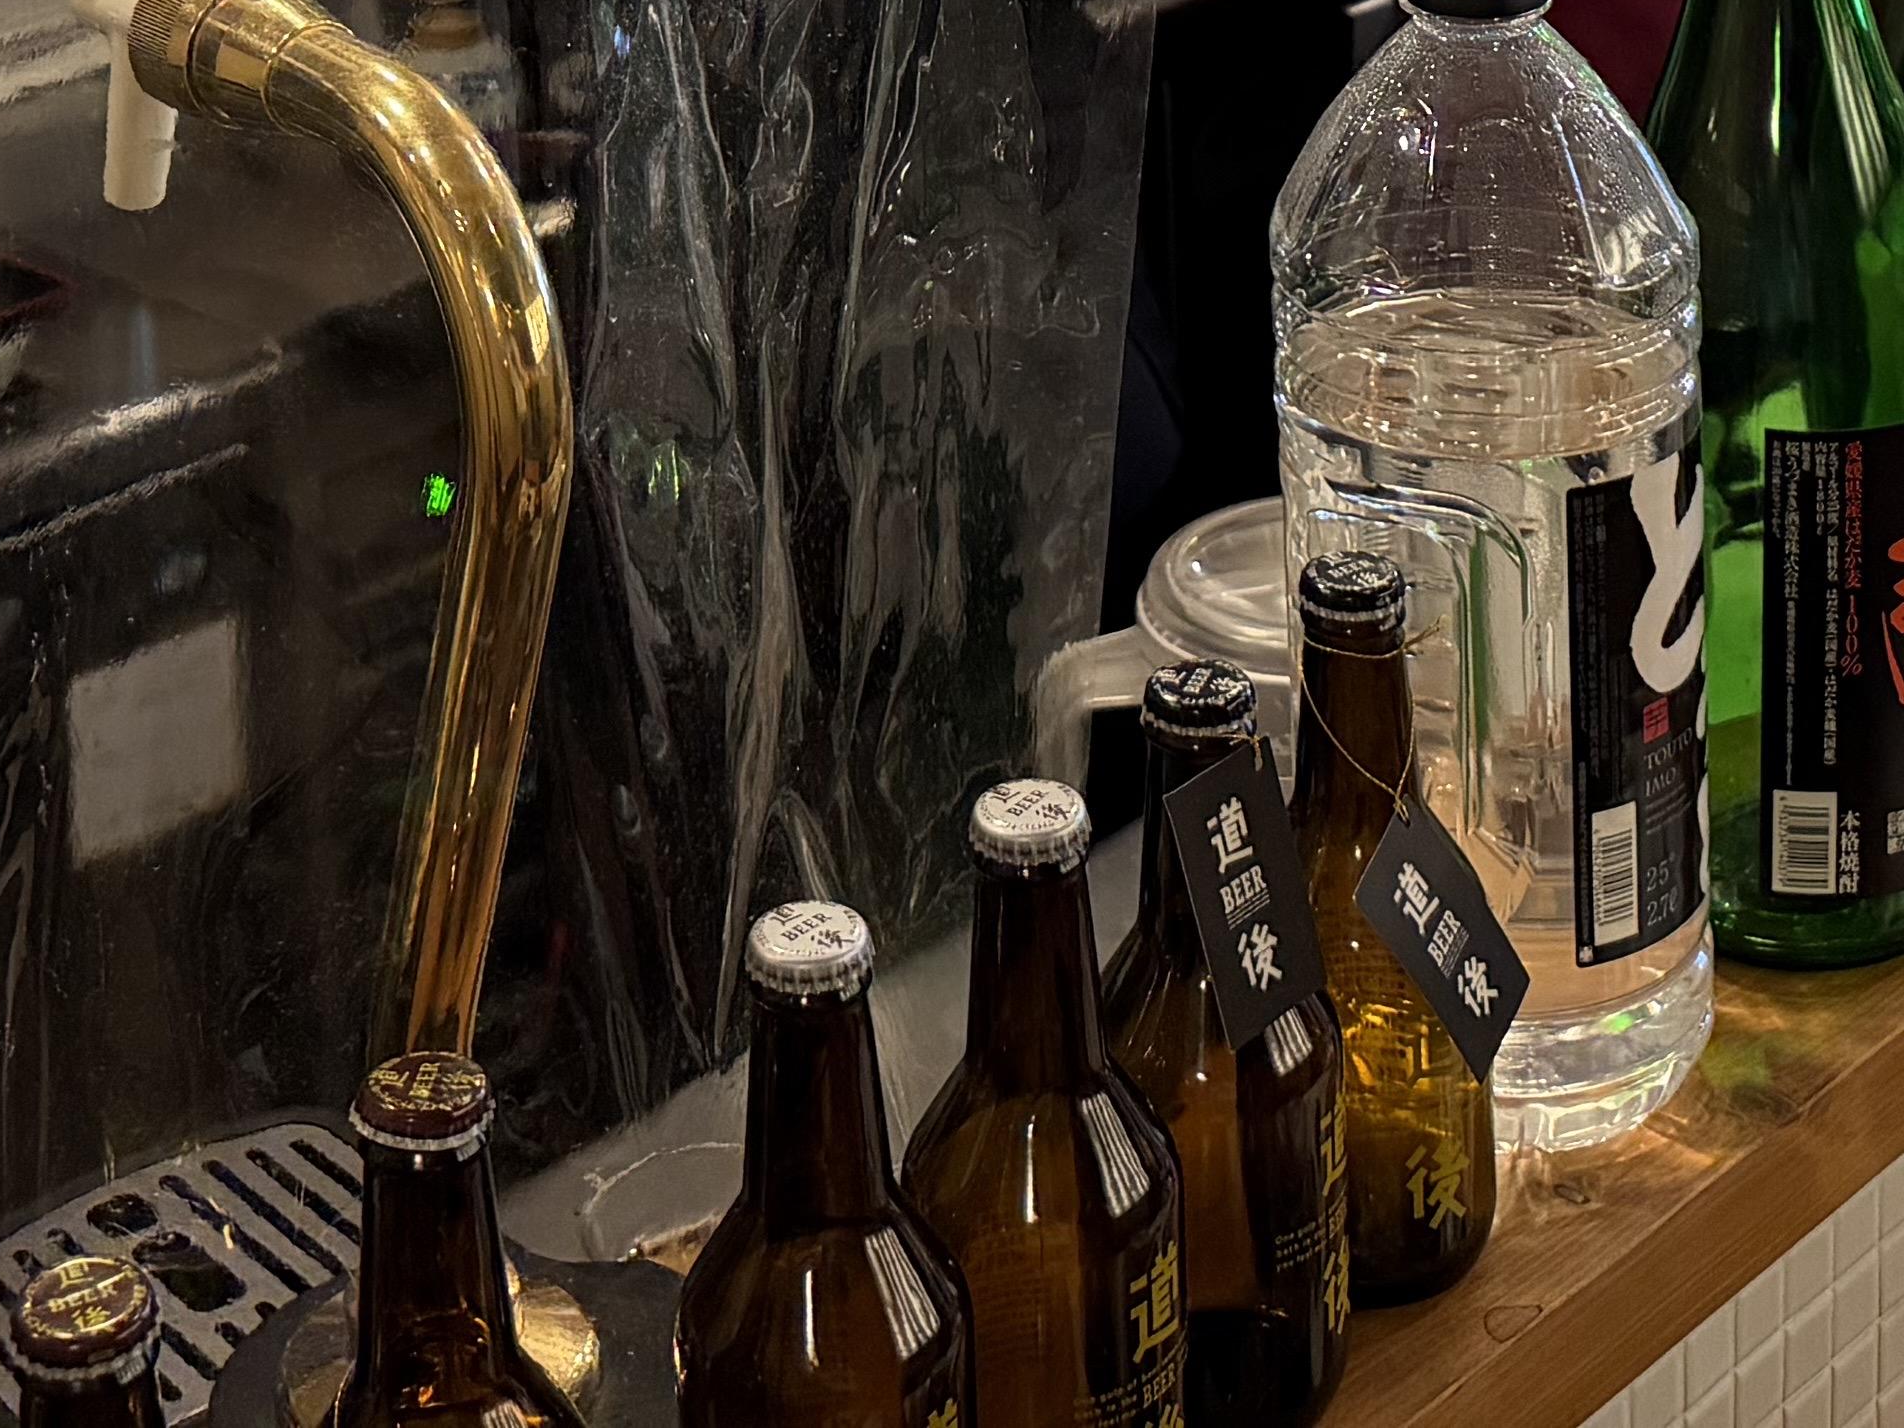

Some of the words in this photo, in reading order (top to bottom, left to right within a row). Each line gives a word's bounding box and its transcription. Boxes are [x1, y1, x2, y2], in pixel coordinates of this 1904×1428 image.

[1845, 440, 1863, 589] 愛媛県産はだか麦
[1840, 594, 1863, 677] 100%
[1643, 726, 1693, 771] TOUTO
[1006, 789, 1049, 817] BEER
[1646, 767, 1678, 797] IMO
[1206, 795, 1254, 875] 道
[1839, 810, 1860, 894] 本格焼酎
[1219, 865, 1268, 915] BEER
[1393, 862, 1440, 937] 道
[781, 912, 832, 942] BEER
[1237, 922, 1283, 992] 後
[1426, 909, 1462, 968] BEER
[1457, 956, 1499, 1018] 後
[1405, 1143, 1471, 1231] 後
[47, 1284, 121, 1313] BEER
[1130, 1240, 1179, 1365] 道
[1142, 1361, 1177, 1410] BEER
